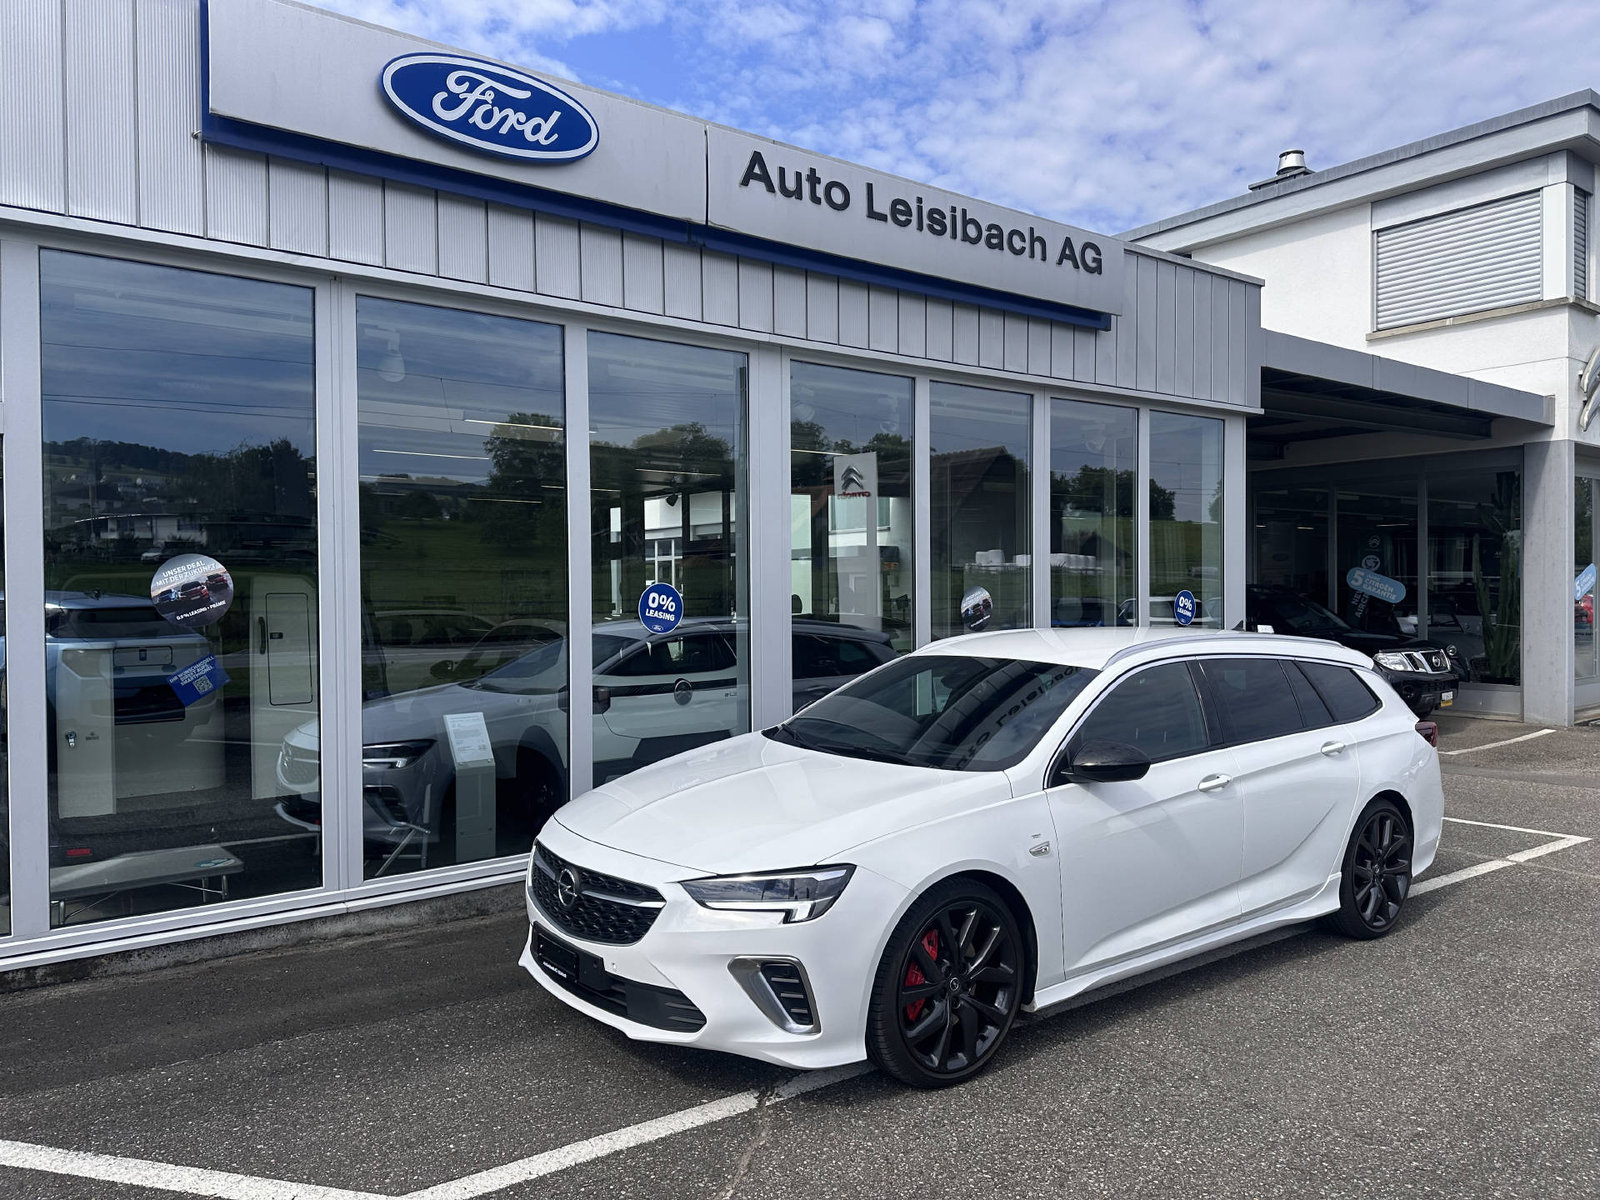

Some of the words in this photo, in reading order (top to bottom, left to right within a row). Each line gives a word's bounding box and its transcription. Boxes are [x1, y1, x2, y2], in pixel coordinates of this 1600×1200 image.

[432, 70, 561, 145] Ford
[739, 150, 851, 211] Auto
[866, 182, 1047, 262] Leisibach
[1056, 236, 1103, 275] AG
[156, 577, 169, 587] MIT
[169, 573, 184, 584] DER
[183, 563, 217, 579] ZUKUNFT
[162, 566, 187, 578] UNSER
[186, 560, 205, 571] DEAL
[1351, 570, 1365, 586] 5
[648, 592, 676, 612] 0%
[1179, 596, 1192, 610] 0%
[645, 608, 675, 622] LEASING
